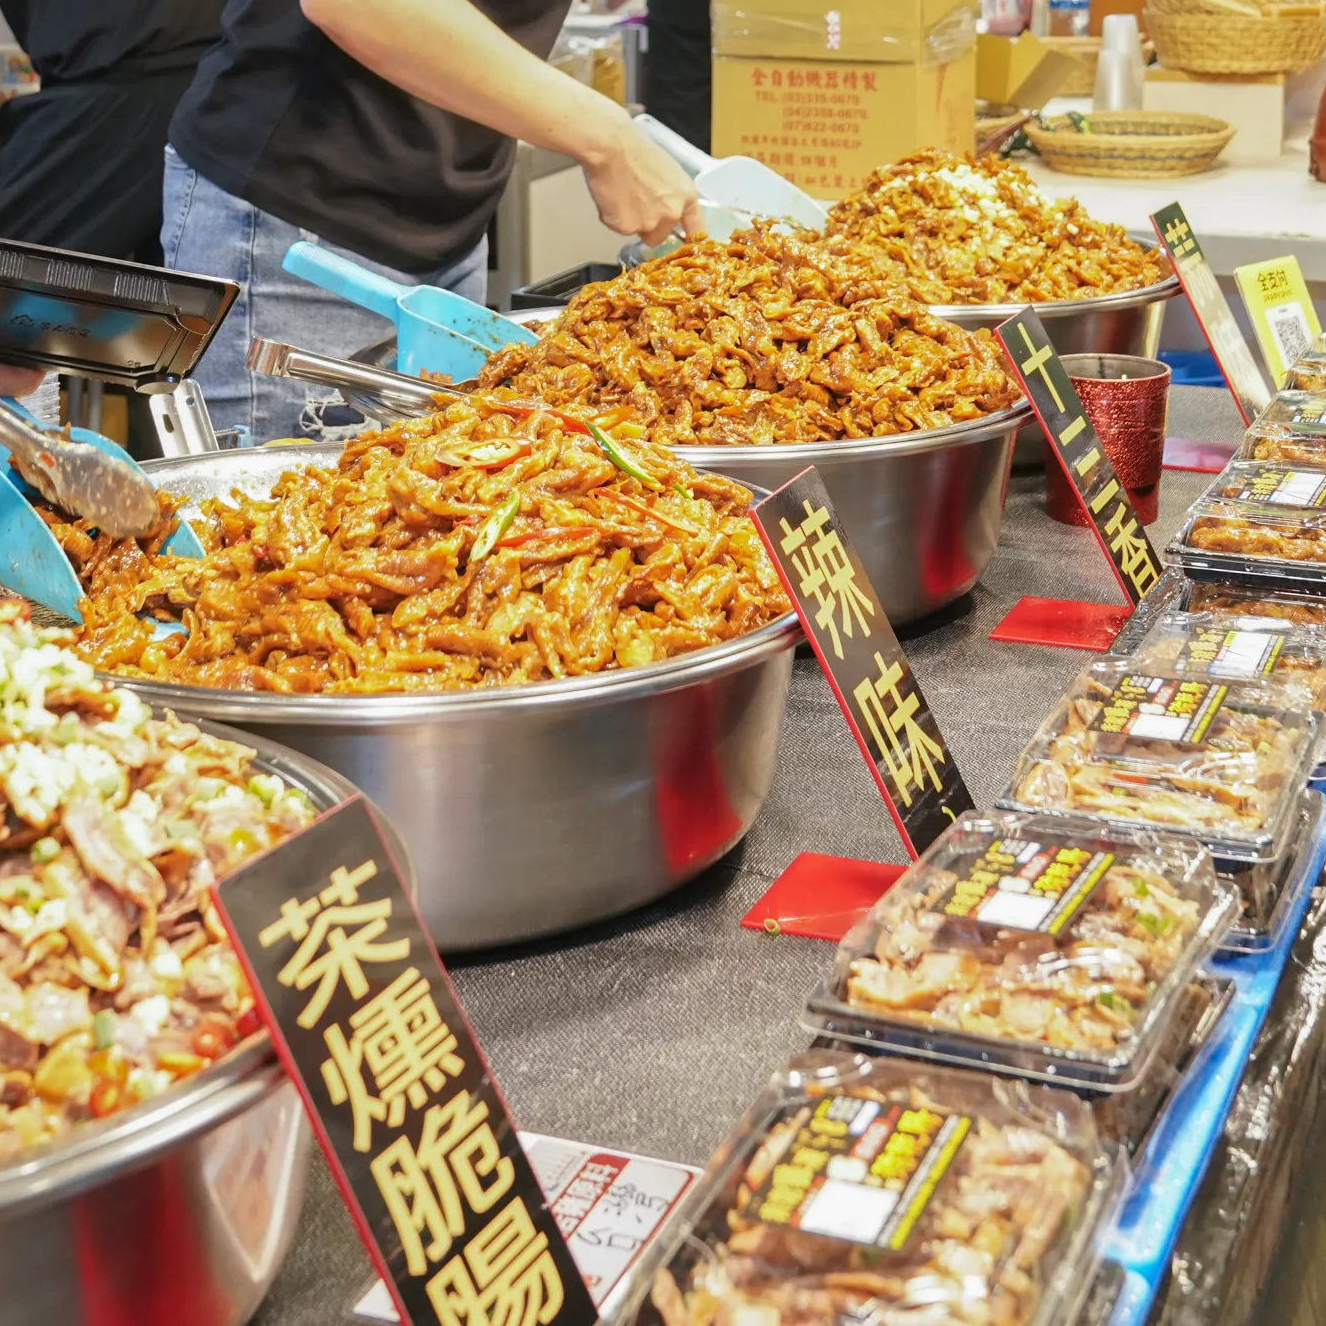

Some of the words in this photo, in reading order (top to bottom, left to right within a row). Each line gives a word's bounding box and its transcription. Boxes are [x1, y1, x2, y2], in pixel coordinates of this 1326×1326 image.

[1257, 269, 1289, 292] 全支付
[1017, 322, 1161, 599] 十三香
[779, 499, 946, 808] 辣味
[258, 859, 564, 1326] 茶燻脆腸
